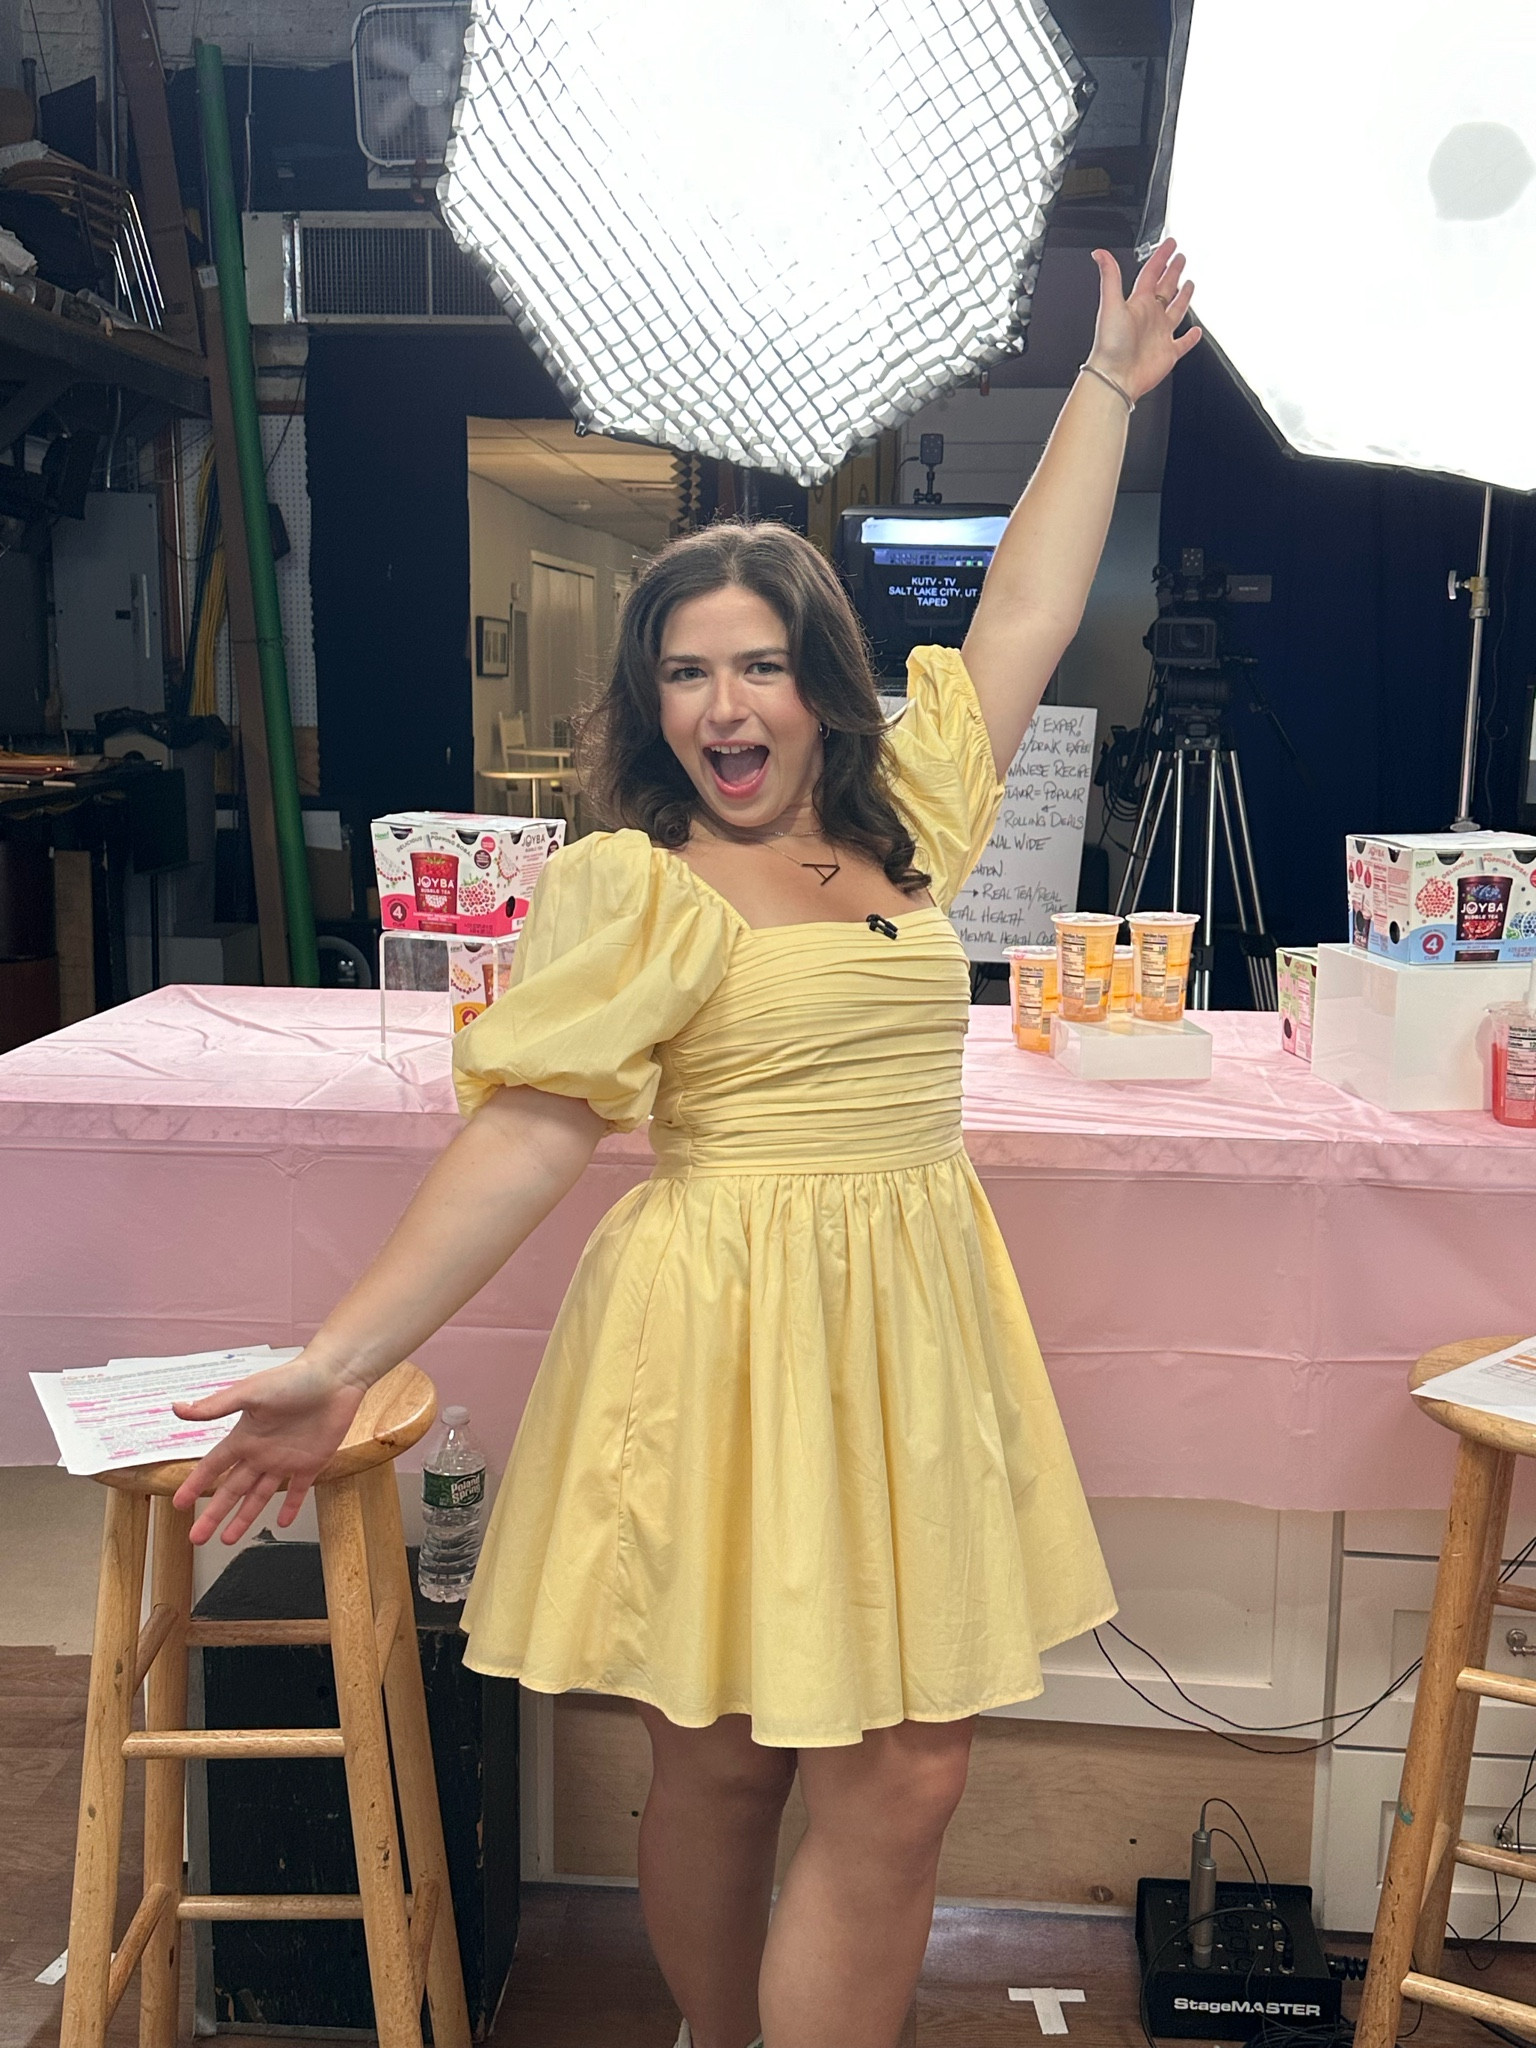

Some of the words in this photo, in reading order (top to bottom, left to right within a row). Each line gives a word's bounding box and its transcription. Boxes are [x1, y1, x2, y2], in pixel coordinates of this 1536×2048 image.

[911, 577, 937, 586] KUTV
[944, 578, 956, 586] TV
[888, 586, 912, 595] SALT
[914, 587, 938, 596] LAKE
[939, 588, 963, 598] CITY,
[965, 588, 978, 597] UT
[917, 597, 948, 607] TAPED
[1003, 810, 1047, 828] ROLLING
[1050, 811, 1084, 830] DEALS
[396, 836, 422, 853] DELICIOUS
[521, 834, 546, 848] JOYBA
[1014, 833, 1052, 851] WIDE
[1483, 856, 1510, 866] POPPING
[1442, 859, 1474, 879] DELICIOUS
[417, 876, 454, 888] JOYBA
[982, 883, 1012, 901] REAL
[392, 905, 402, 919] 4
[1460, 902, 1504, 914] JOYBA
[981, 906, 1025, 926] HEALTH
[960, 928, 998, 943] MENTAL
[1425, 937, 1438, 952] 4
[451, 1473, 480, 1494] Poland
[452, 1486, 481, 1504] Spring
[1173, 1997, 1321, 2017] StageMASTER
